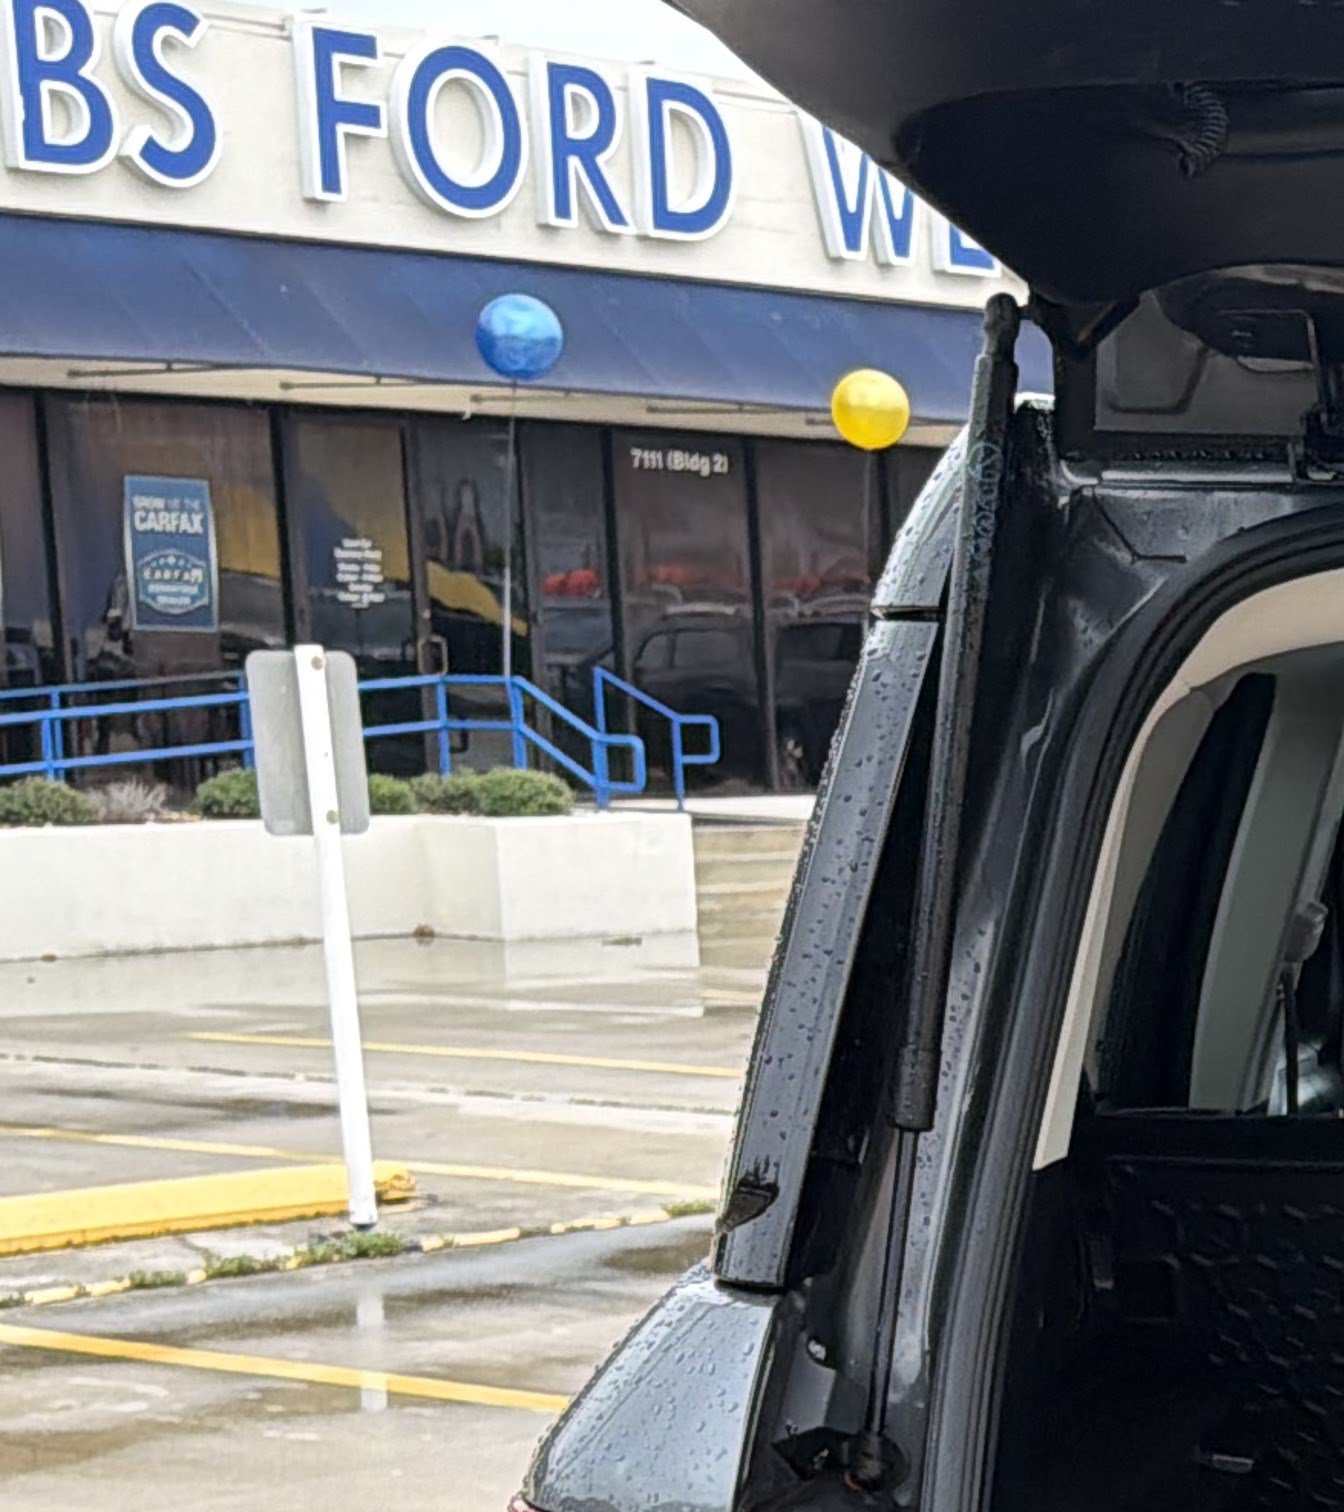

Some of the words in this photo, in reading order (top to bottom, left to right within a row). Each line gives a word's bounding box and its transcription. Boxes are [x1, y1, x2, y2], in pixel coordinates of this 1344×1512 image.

[302, 22, 735, 241] FORD
[630, 447, 663, 470] 7111
[134, 510, 205, 534] CARFAX
